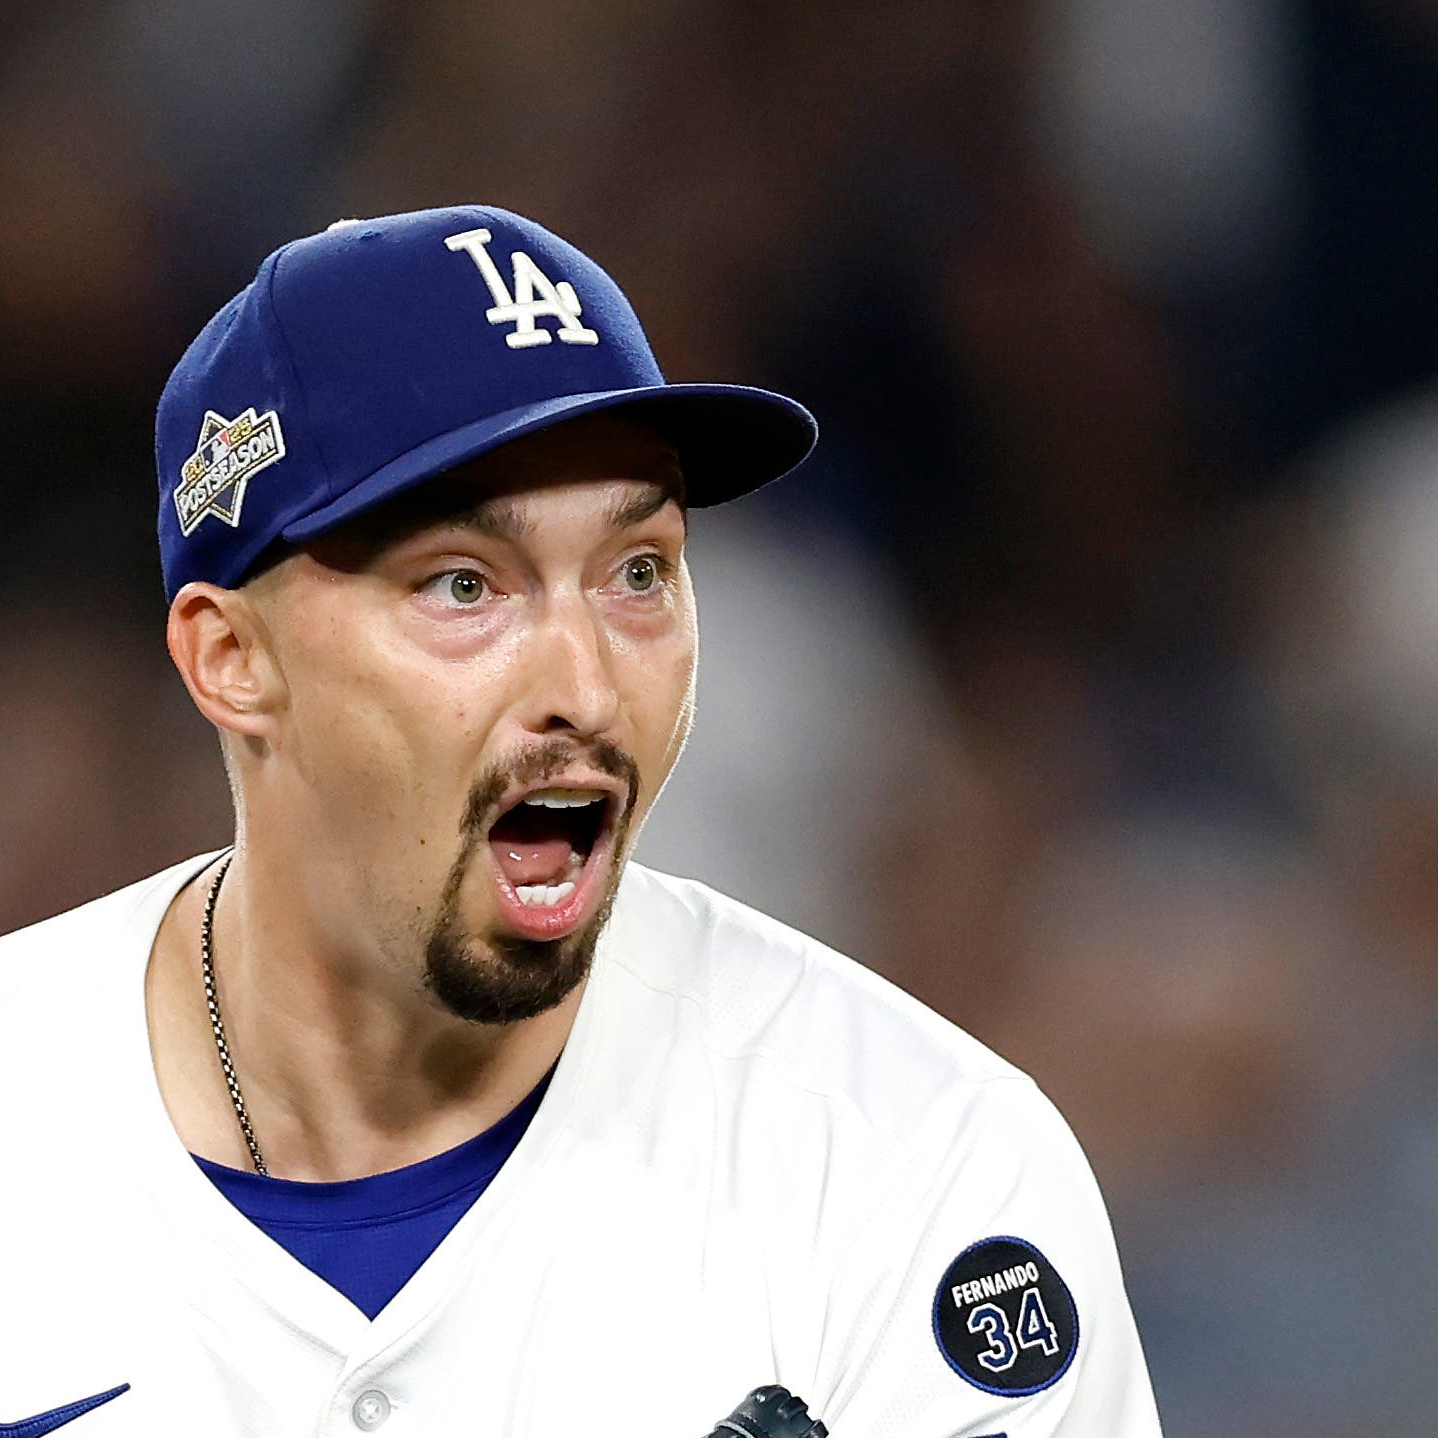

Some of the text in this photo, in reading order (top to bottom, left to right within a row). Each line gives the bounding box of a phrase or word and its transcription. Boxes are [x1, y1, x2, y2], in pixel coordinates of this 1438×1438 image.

[444, 228, 599, 349] LA
[178, 426, 276, 522] POSTSEASON
[951, 1261, 1040, 1308] FERNANDO
[966, 1287, 1060, 1373] 34
